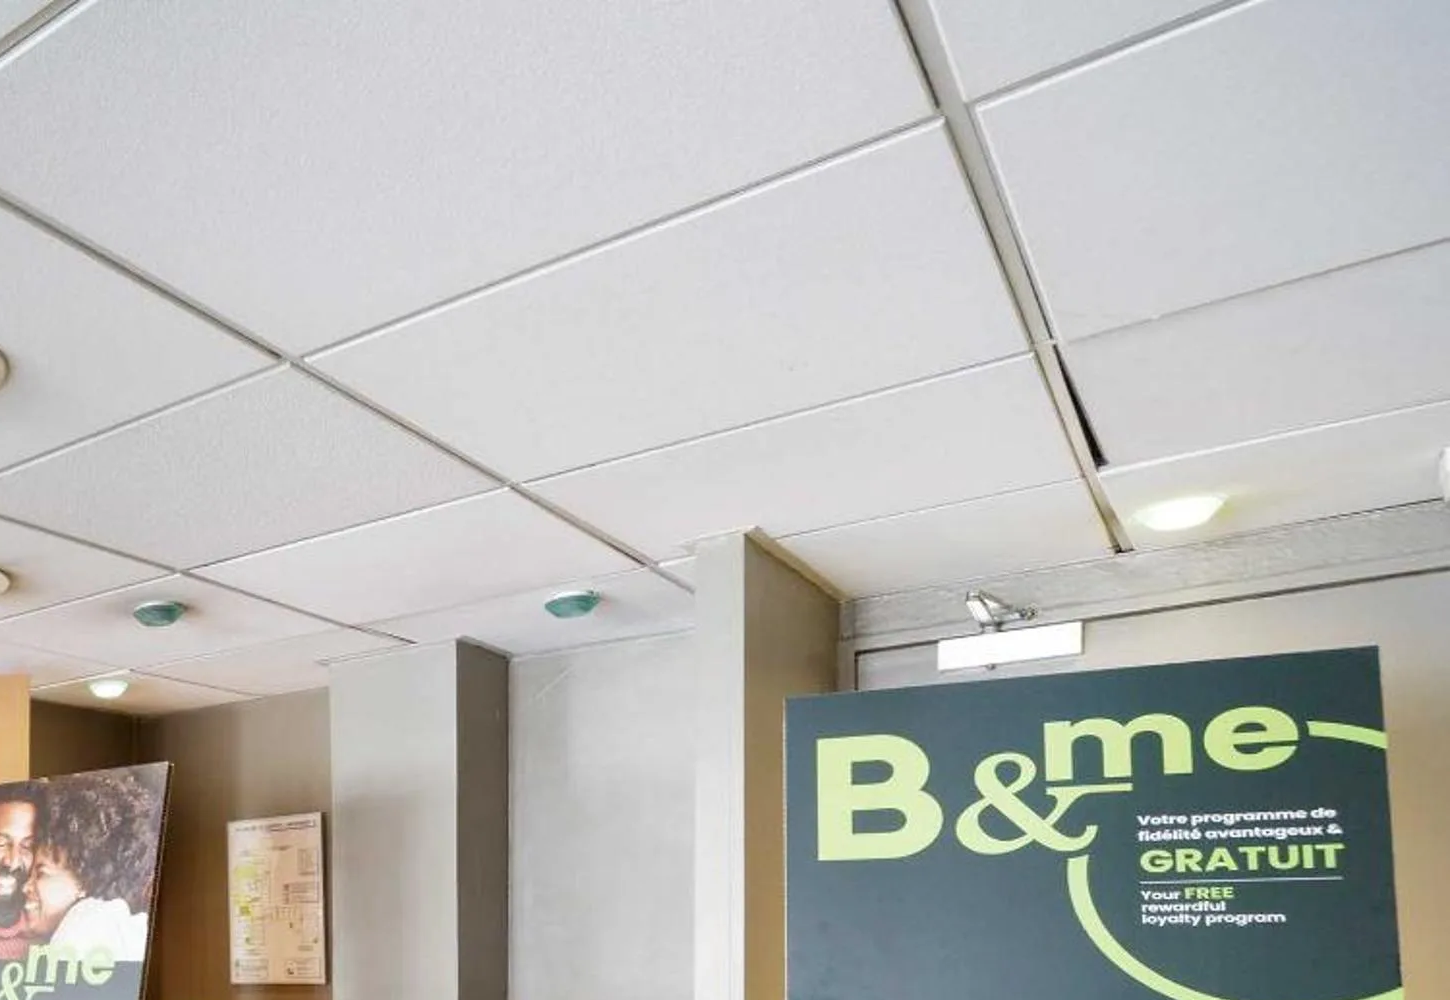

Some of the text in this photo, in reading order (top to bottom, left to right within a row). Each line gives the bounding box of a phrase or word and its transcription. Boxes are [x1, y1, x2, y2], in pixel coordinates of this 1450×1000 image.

[1136, 807, 1337, 826] Votre programme de
[1137, 823, 1343, 842] fidélité avantageux &
[1140, 843, 1345, 873] GRATUIT
[1141, 886, 1235, 900] Your FREE
[1141, 901, 1226, 912] rewardful
[1142, 913, 1286, 927] loyalty program
